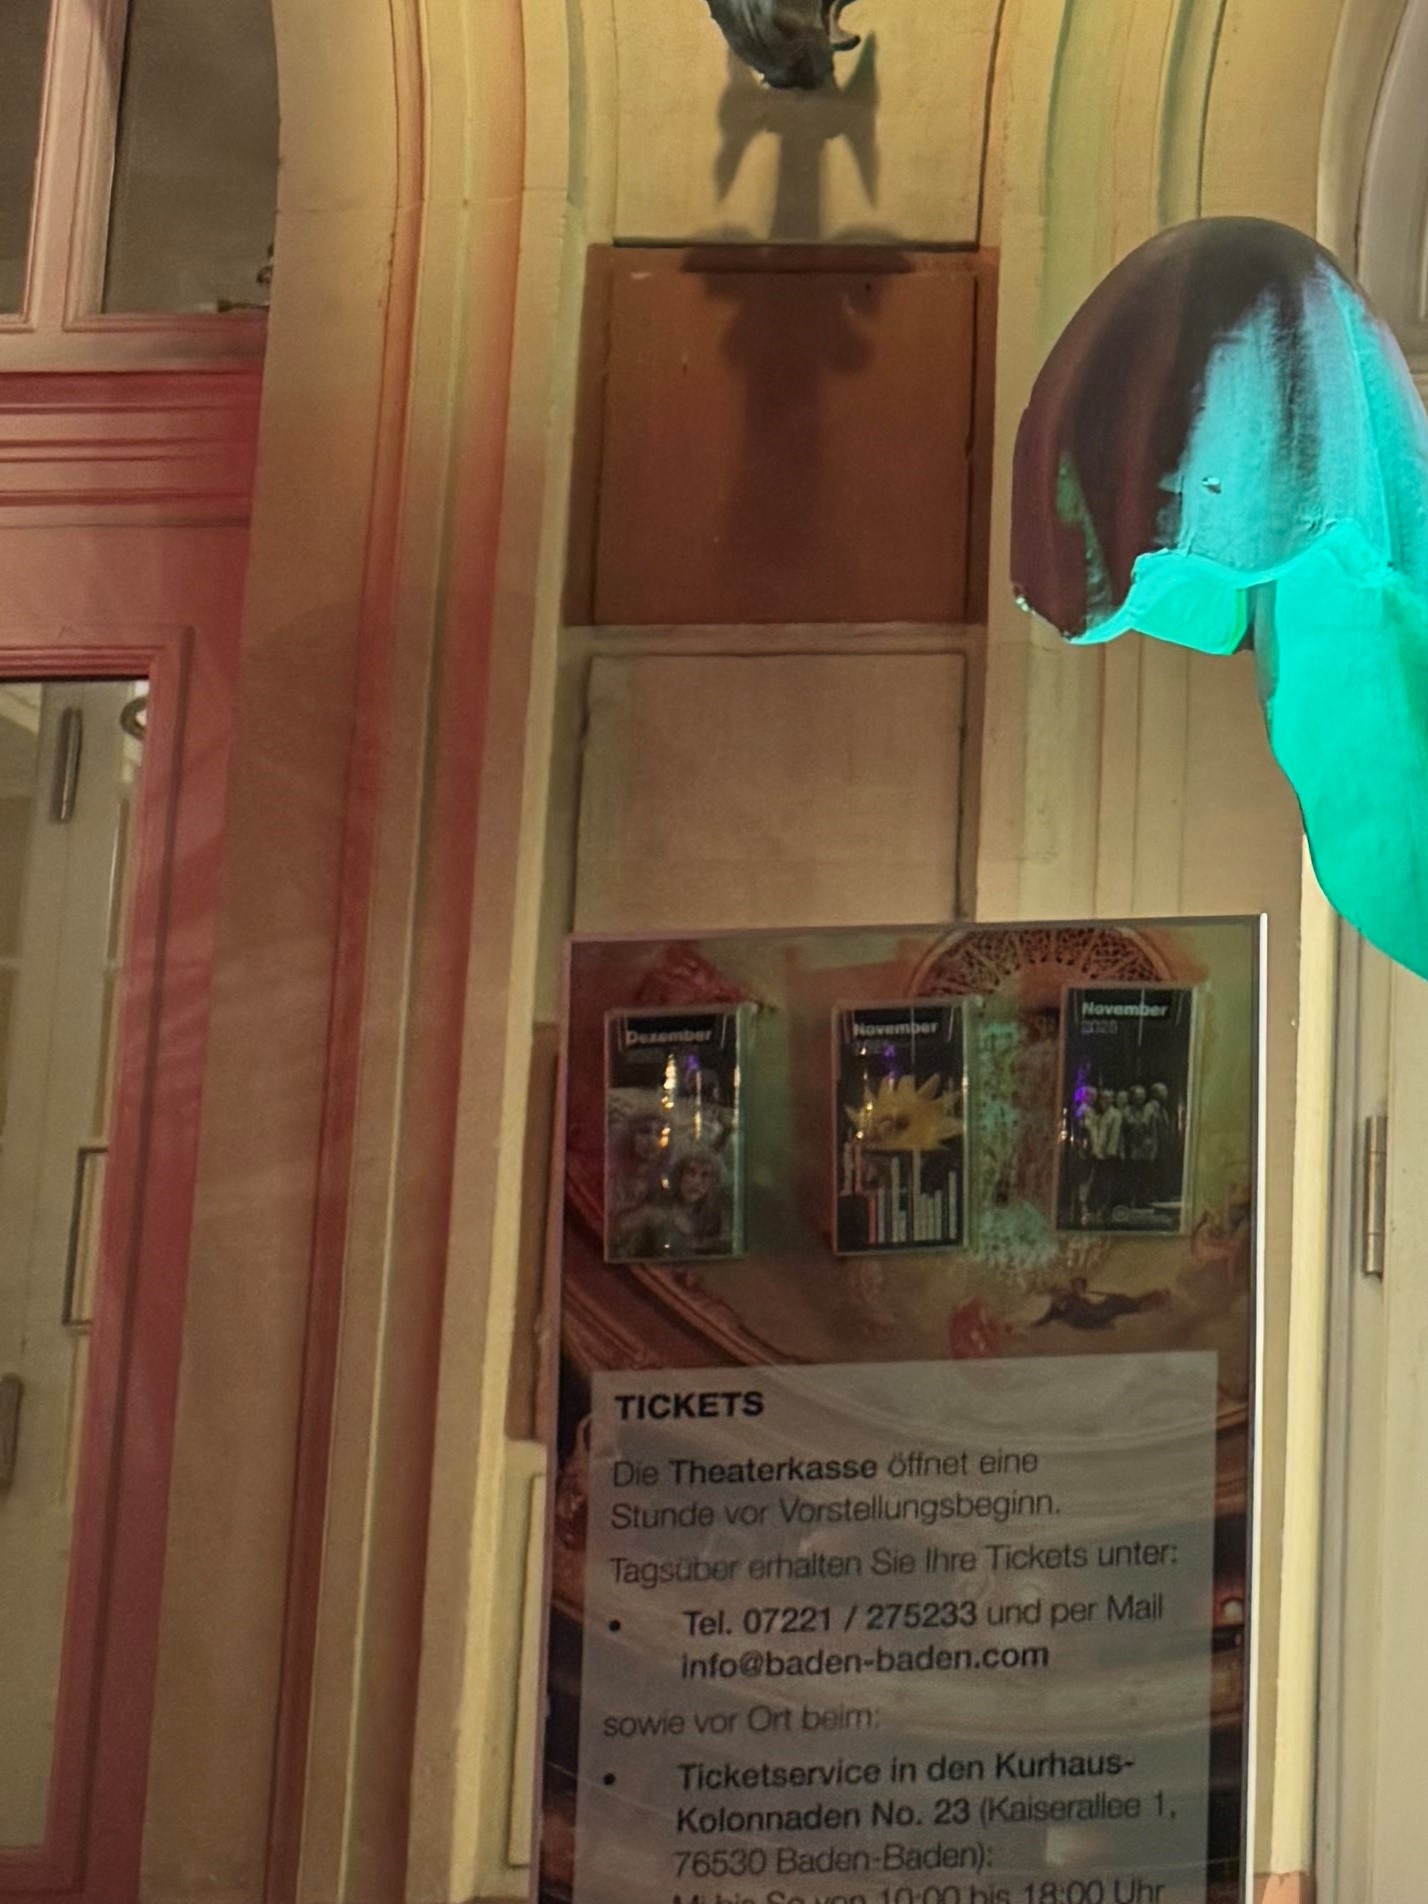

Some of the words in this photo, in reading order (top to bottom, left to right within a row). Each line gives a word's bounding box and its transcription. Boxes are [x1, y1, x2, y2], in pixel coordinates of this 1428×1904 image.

[1082, 1002, 1168, 1017] November
[626, 1030, 712, 1043] Dezember
[853, 1022, 937, 1036] November
[615, 1392, 764, 1420] TICKETS
[613, 1459, 659, 1487] Die
[669, 1457, 878, 1485] Theaterkasse
[888, 1451, 968, 1479] öffnet
[980, 1450, 1038, 1474] eine
[611, 1502, 715, 1530] Stunde
[725, 1504, 768, 1526] vor
[779, 1492, 1061, 1526] Vorstellungsbeginn.
[609, 1554, 739, 1590] Tagsüber
[748, 1553, 862, 1580] erhalten
[871, 1550, 916, 1576] Sie
[925, 1547, 976, 1574] Ihre
[984, 1544, 1088, 1571] Tickets
[1098, 1541, 1178, 1568] unter:
[682, 1611, 732, 1637] Tel.
[742, 1607, 830, 1635] 07221
[843, 1605, 857, 1633] /
[866, 1603, 977, 1630] 275233
[987, 1600, 1042, 1627] und
[1049, 1602, 1098, 1628] per
[1106, 1596, 1163, 1622] Mail
[681, 1644, 1050, 1681] info@baden-baden.com
[604, 1709, 685, 1739] sowie
[694, 1711, 739, 1734] vor
[747, 1706, 794, 1733] Ort
[802, 1702, 880, 1731] beim:
[678, 1761, 880, 1791] Ticketservice
[890, 1761, 917, 1785] in
[926, 1755, 984, 1783] den
[994, 1750, 1134, 1779] Kurhaus-
[676, 1805, 861, 1835] Kolonnaden
[872, 1801, 923, 1829] No.
[933, 1799, 970, 1825] 23
[979, 1793, 1141, 1827] (Kaiserallee
[674, 1847, 767, 1878] 76530
[777, 1842, 993, 1874] Baden-Baden):
